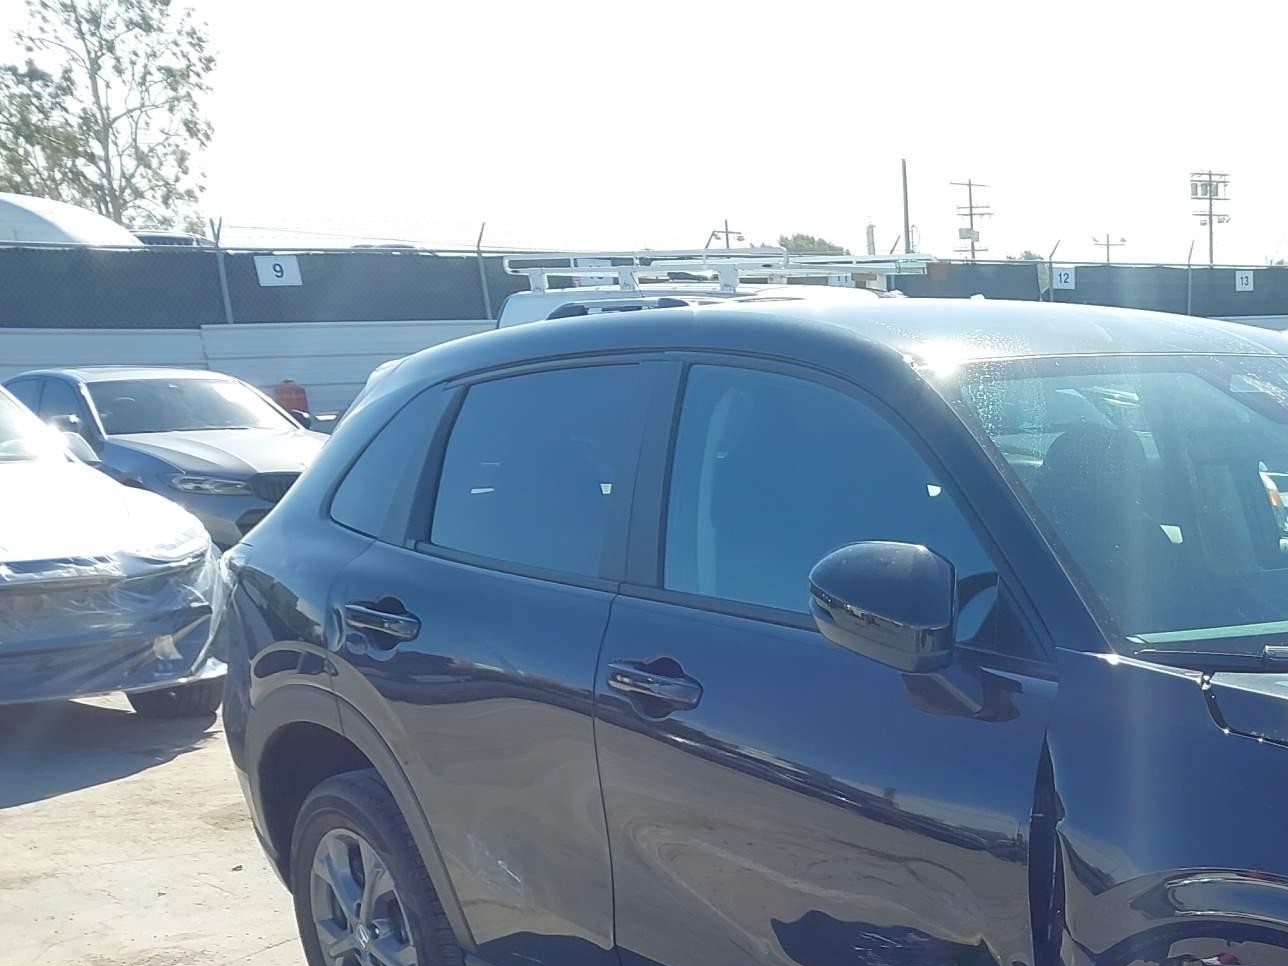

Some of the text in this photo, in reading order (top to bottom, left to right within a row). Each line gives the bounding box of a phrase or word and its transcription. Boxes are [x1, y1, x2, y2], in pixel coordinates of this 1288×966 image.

[273, 263, 284, 278] 9
[1058, 272, 1070, 284] 12
[1240, 275, 1249, 287] 13
